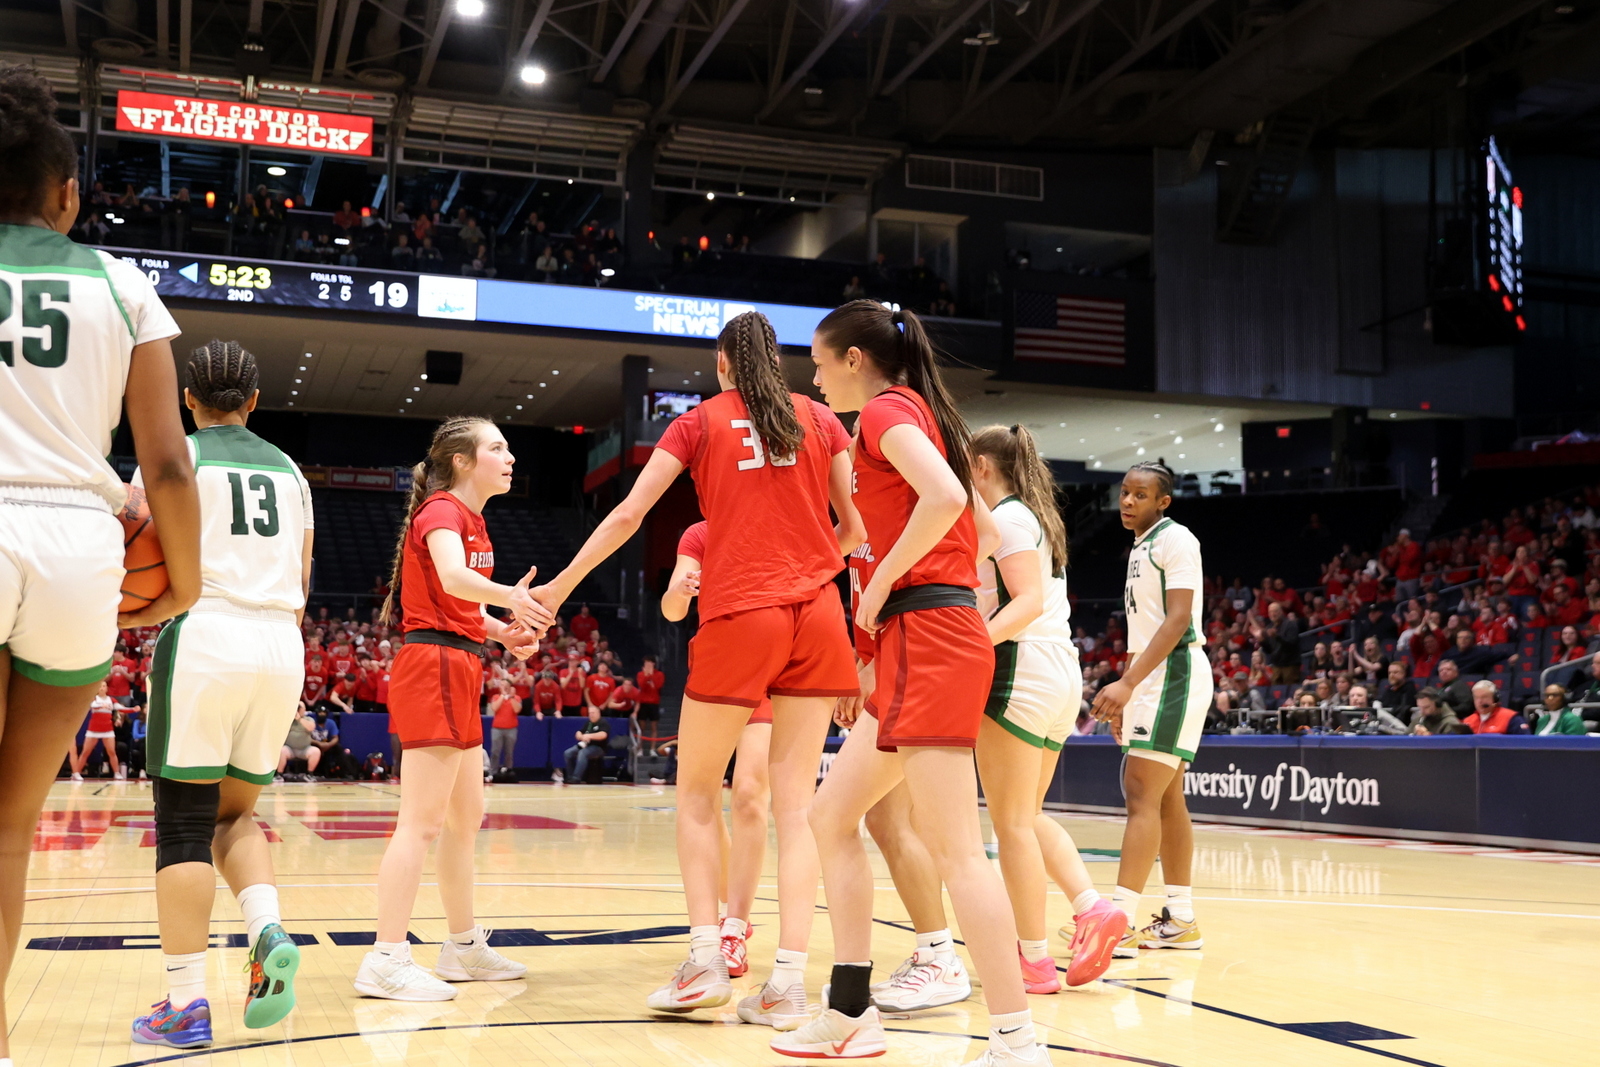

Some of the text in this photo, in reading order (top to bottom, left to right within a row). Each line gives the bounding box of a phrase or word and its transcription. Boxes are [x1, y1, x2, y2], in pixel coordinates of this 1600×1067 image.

[174, 99, 320, 127] THE CONNOR
[141, 107, 351, 151] FLIGHT DECK
[141, 258, 170, 269] FOULS
[209, 263, 271, 289] 5:23
[310, 272, 337, 283] FOULS
[227, 288, 254, 302] 2ND
[318, 283, 352, 301] 2 5
[368, 281, 409, 308] 19
[634, 295, 720, 317] SPECTRUM
[653, 313, 720, 337] NEWS
[227, 471, 280, 537] 13
[1183, 762, 1381, 815] iversity of Dayton
